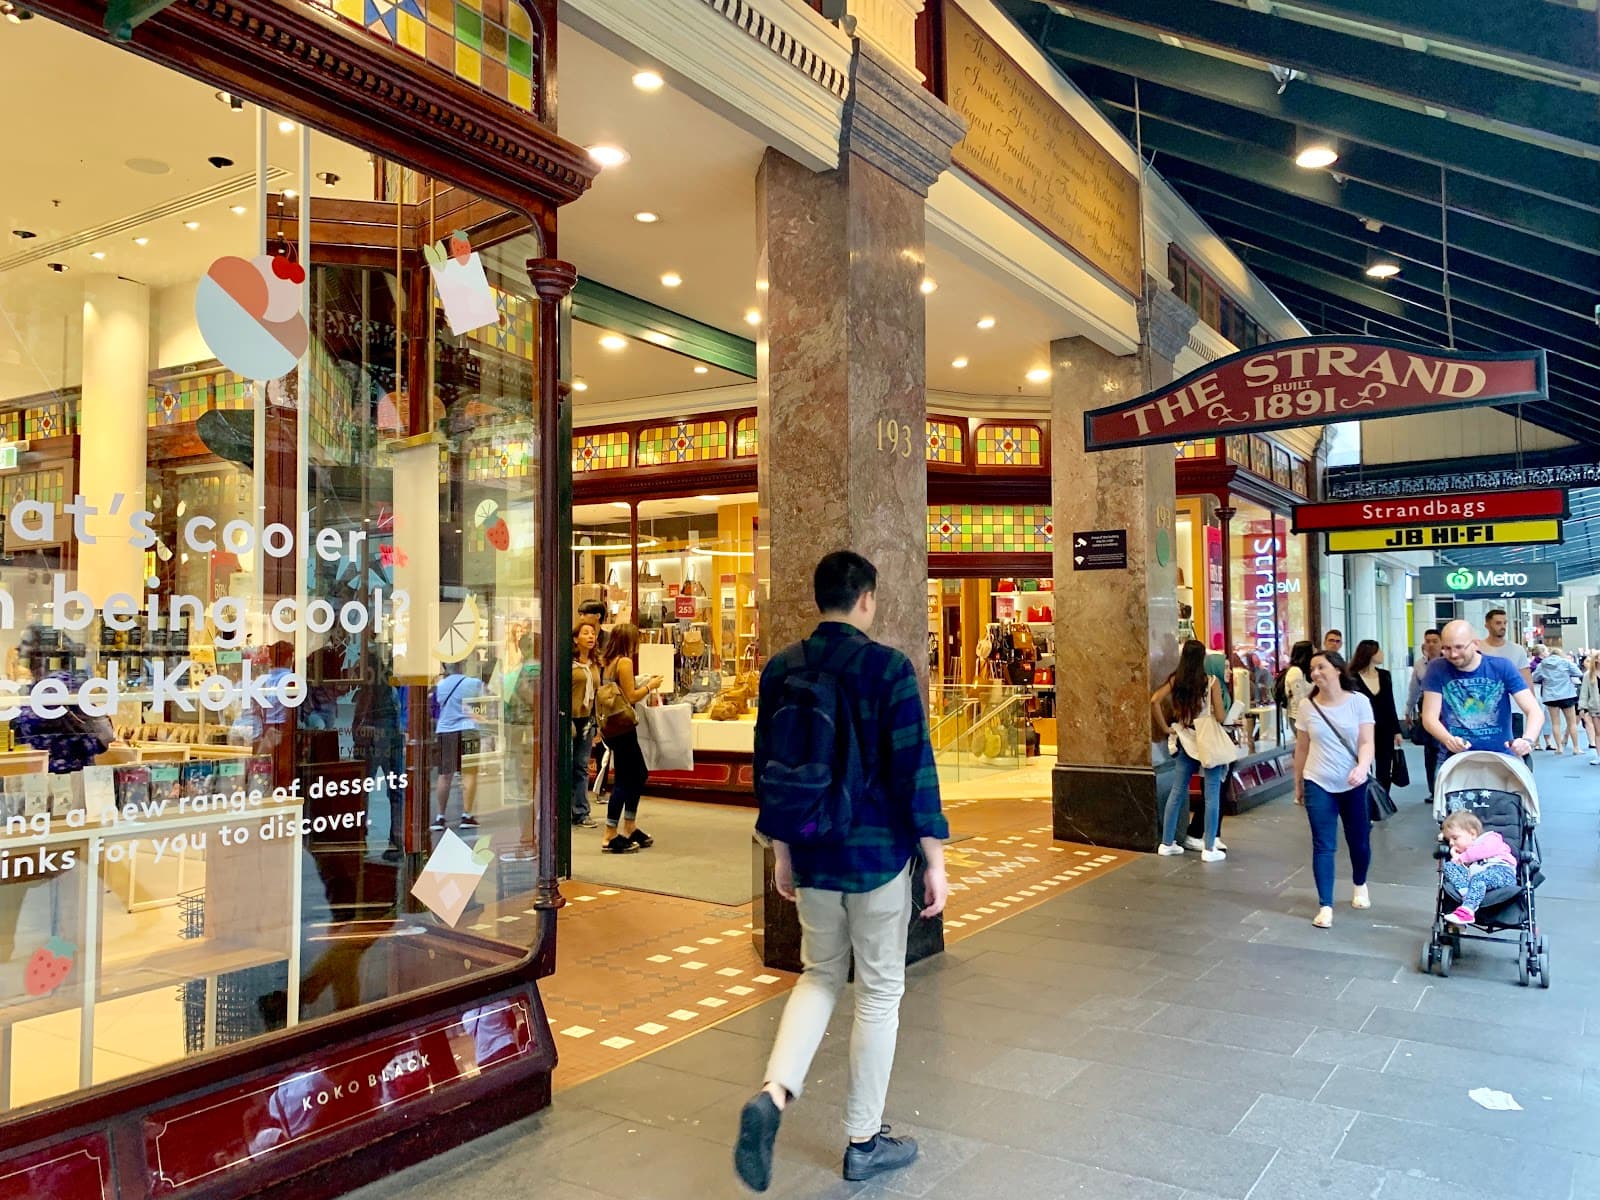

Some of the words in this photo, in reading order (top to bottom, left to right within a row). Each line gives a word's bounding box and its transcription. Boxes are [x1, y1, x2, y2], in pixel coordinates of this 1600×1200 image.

[1122, 372, 1226, 437] THE
[1242, 346, 1487, 399] STRAND
[1253, 387, 1336, 422] 1891
[1272, 379, 1314, 394] BUILT
[876, 417, 912, 458] 193
[1362, 499, 1486, 520] Strandbags
[184, 511, 367, 563] cooler
[1385, 528, 1423, 547] JB
[1476, 570, 1528, 587] Metro
[52, 573, 248, 650] being
[271, 587, 411, 634] cool?
[152, 658, 308, 713] Koko
[0, 810, 51, 841] ng
[66, 808, 87, 828] a
[100, 797, 167, 826] new
[179, 787, 263, 816] range
[272, 778, 300, 803] of
[308, 766, 409, 801] desserts
[1, 846, 76, 880] inks
[90, 836, 136, 866] for
[152, 830, 207, 864] you
[218, 825, 249, 847] to
[260, 811, 372, 842] discover.
[302, 1080, 360, 1111] KOKO
[367, 1053, 431, 1088] BLACK
